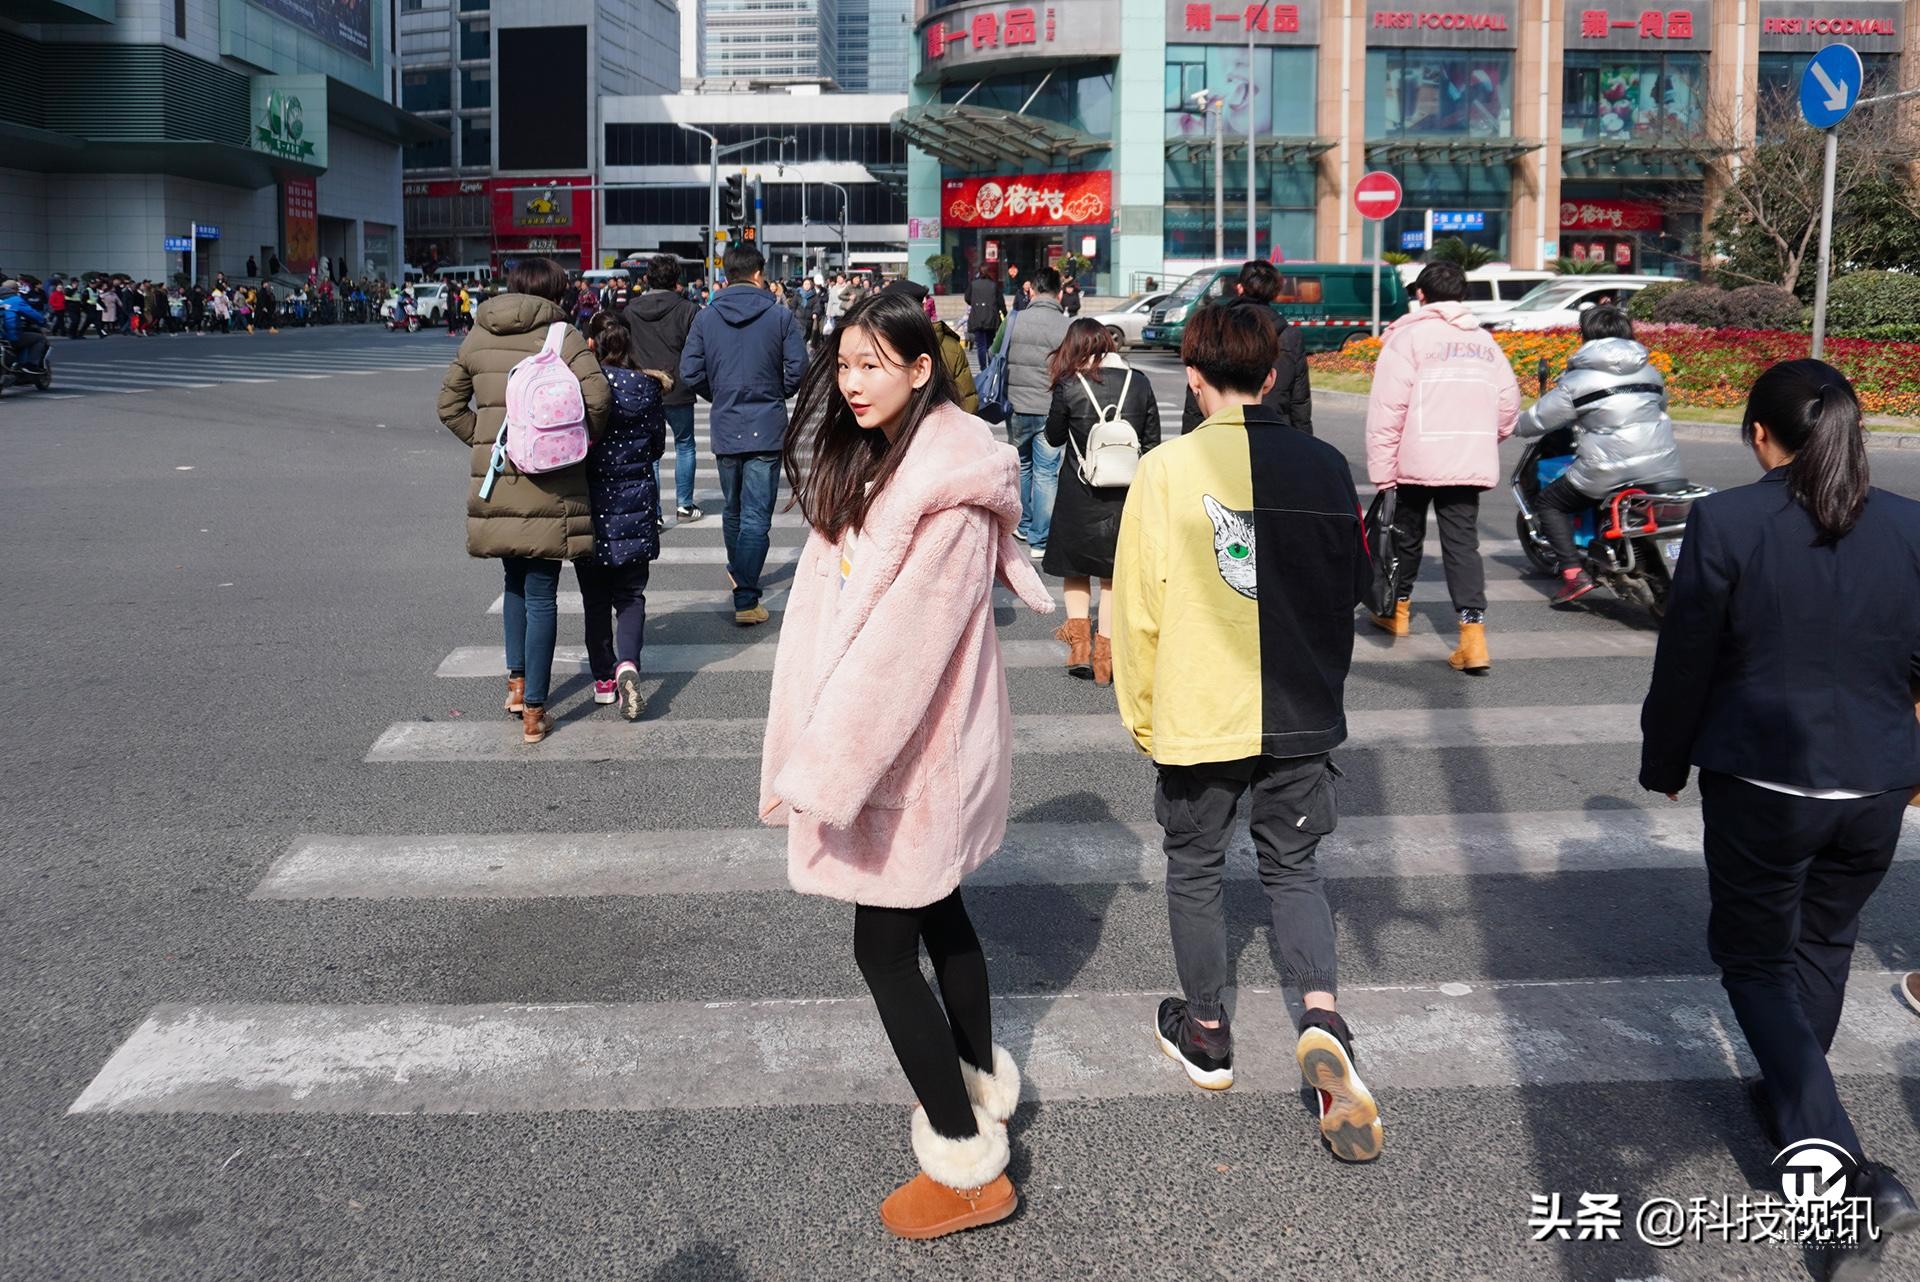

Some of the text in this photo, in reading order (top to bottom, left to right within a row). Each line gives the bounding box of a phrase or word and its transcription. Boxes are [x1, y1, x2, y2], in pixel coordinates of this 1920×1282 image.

[1185, 3, 1299, 32] 第一食品
[1374, 11, 1508, 31] FIRST FOODMALL
[1582, 9, 1693, 39] 第一食品
[1763, 17, 1896, 36] FIRST FOODMALL
[927, 8, 1036, 58] 第一食品
[1004, 183, 1065, 220] 猪年大吉
[1580, 203, 1623, 227] 猪年大吉
[1441, 342, 1496, 363] JESUS
